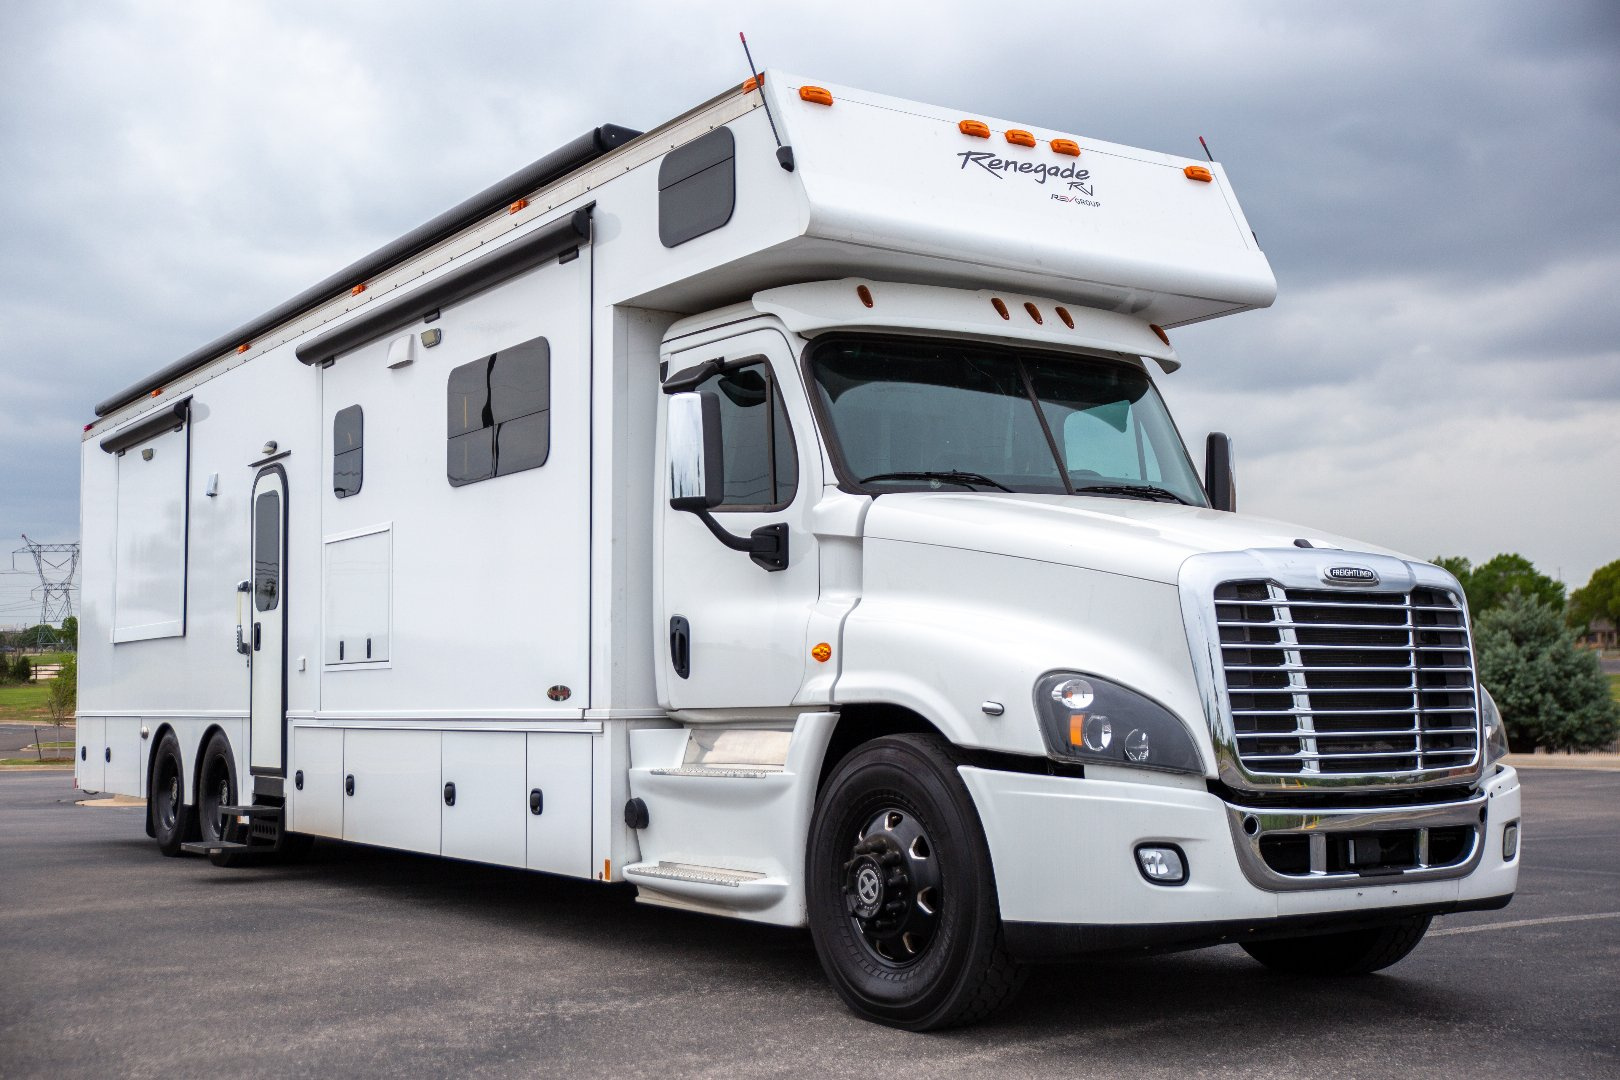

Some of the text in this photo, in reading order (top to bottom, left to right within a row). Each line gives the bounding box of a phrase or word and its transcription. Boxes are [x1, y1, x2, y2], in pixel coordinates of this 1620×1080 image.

[957, 150, 1090, 184] Renegade
[1067, 181, 1093, 196] RV
[1075, 198, 1101, 207] GROUP
[1332, 569, 1372, 578] FREIGHTLINER
